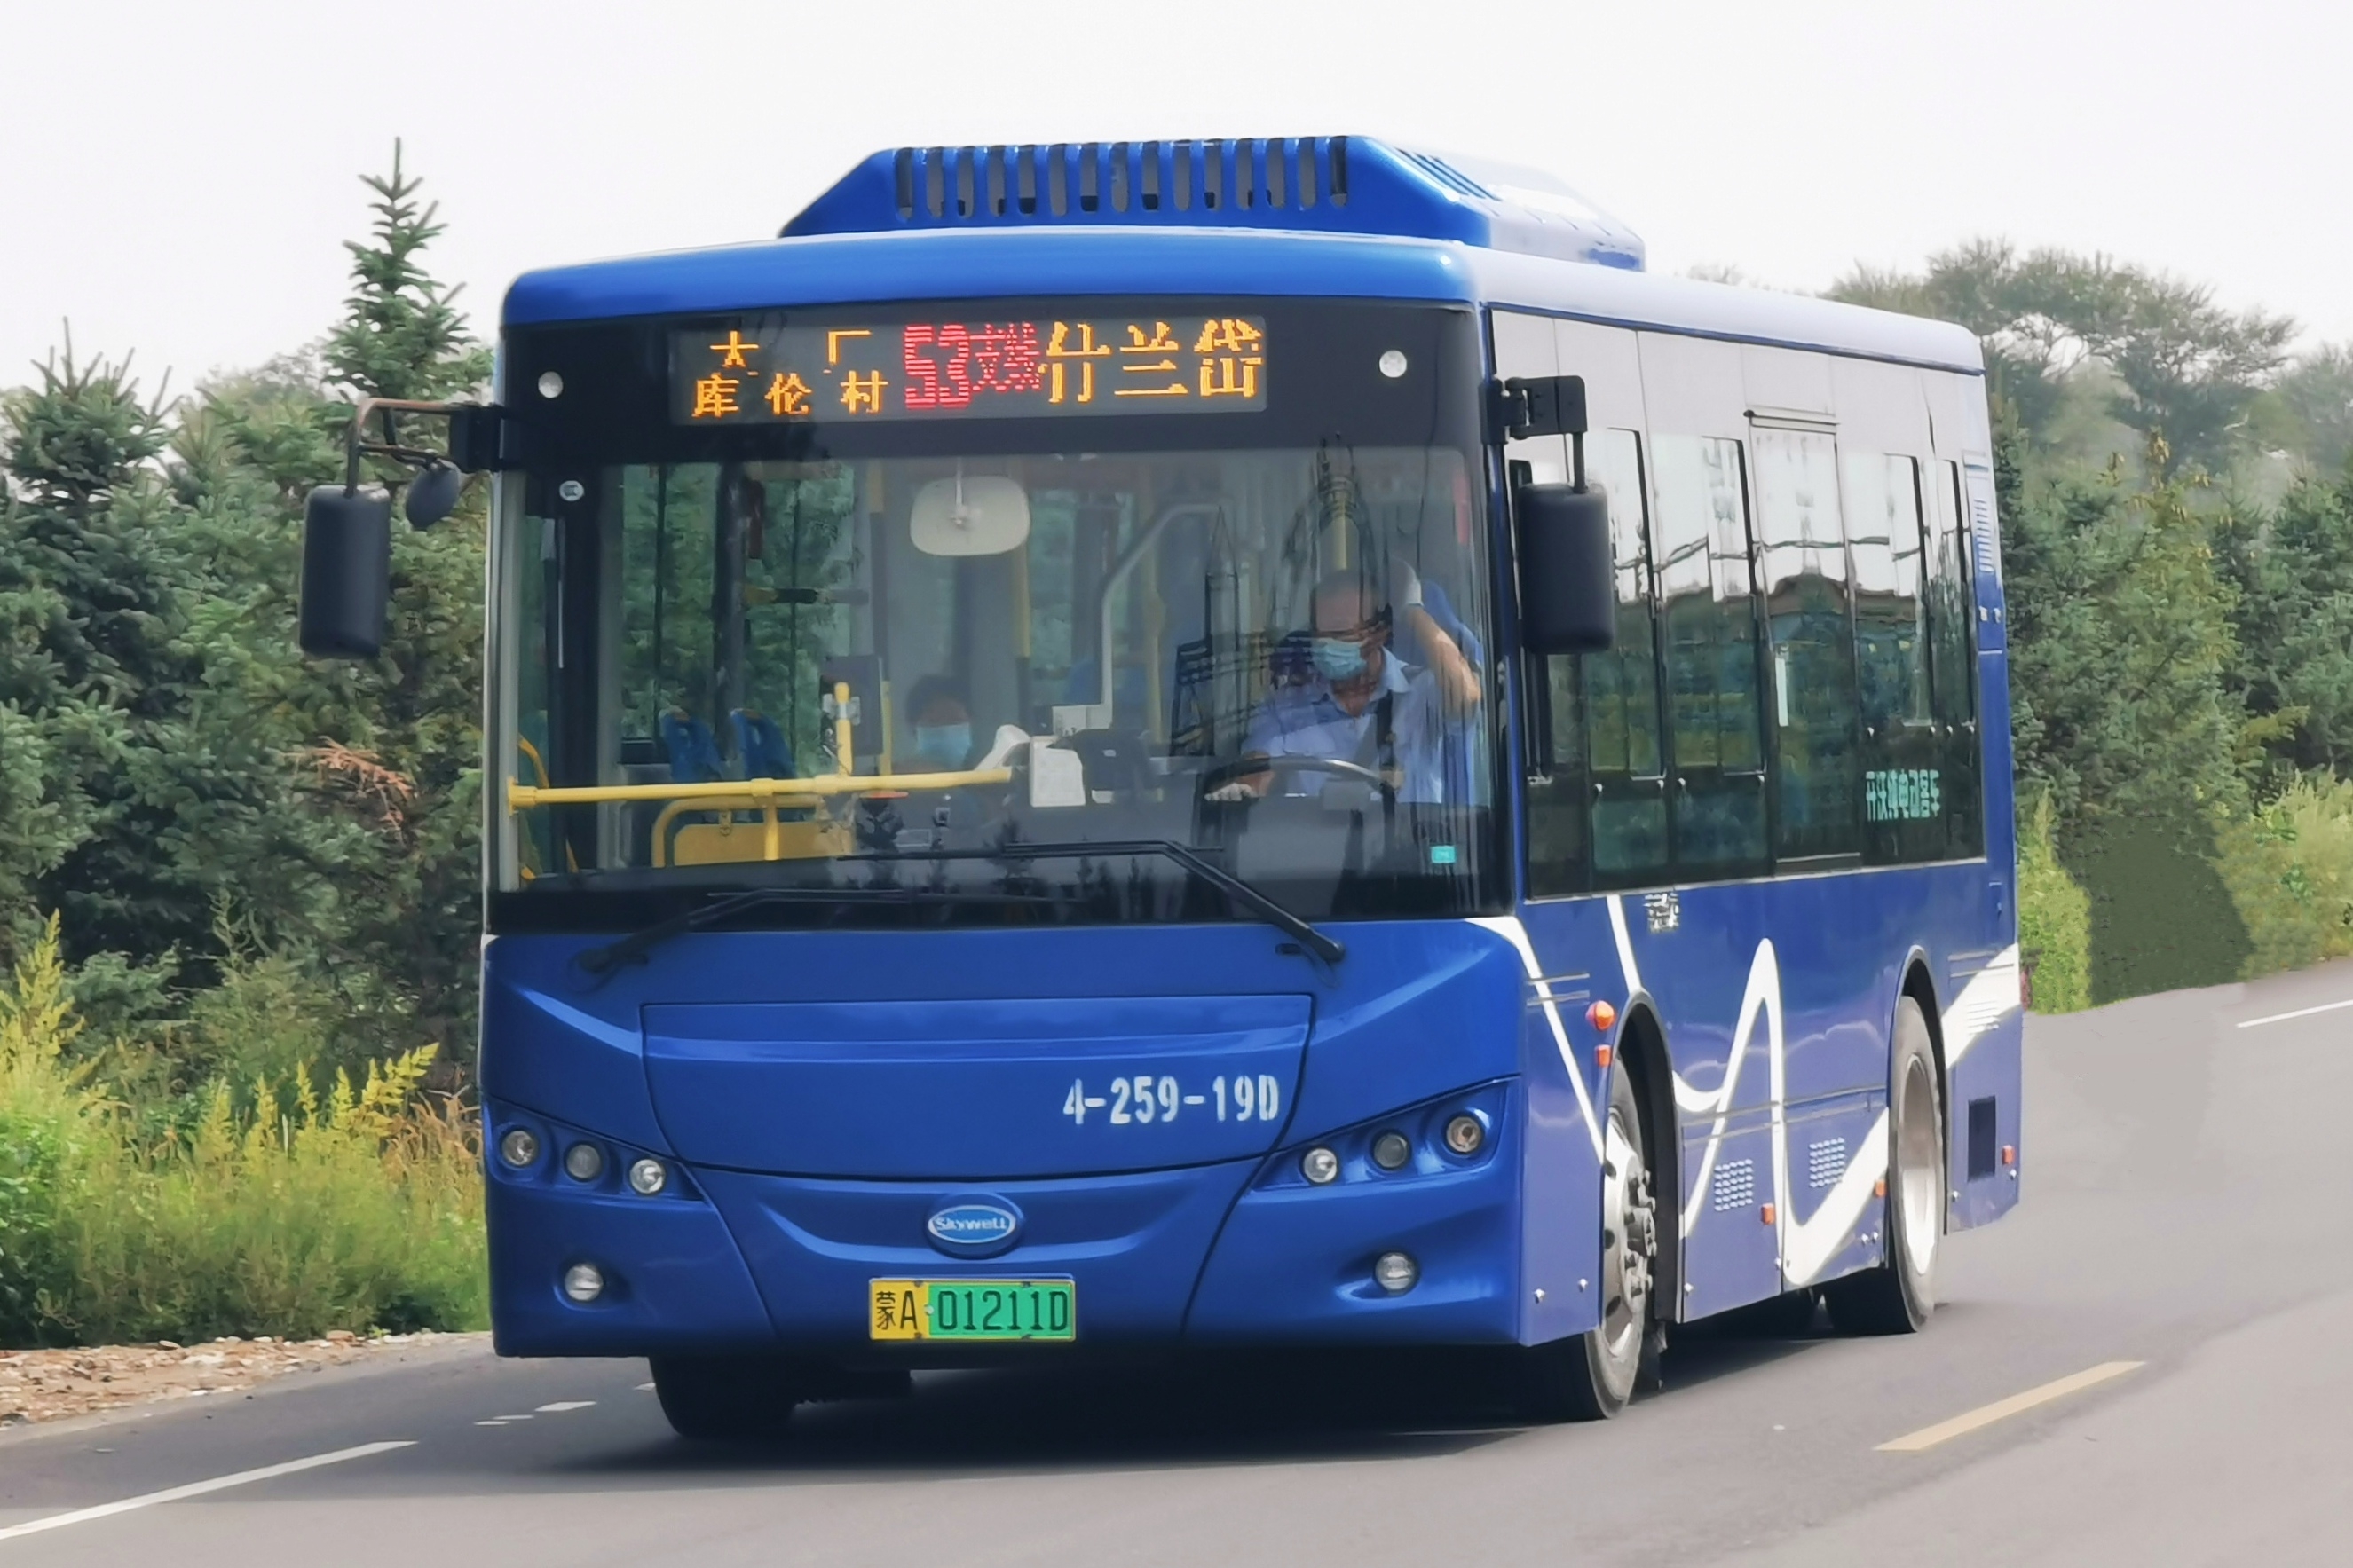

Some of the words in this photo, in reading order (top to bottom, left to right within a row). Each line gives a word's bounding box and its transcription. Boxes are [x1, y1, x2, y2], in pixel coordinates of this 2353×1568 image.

[691, 370, 888, 418] 库伦村
[1037, 319, 1263, 404] 什兰岱
